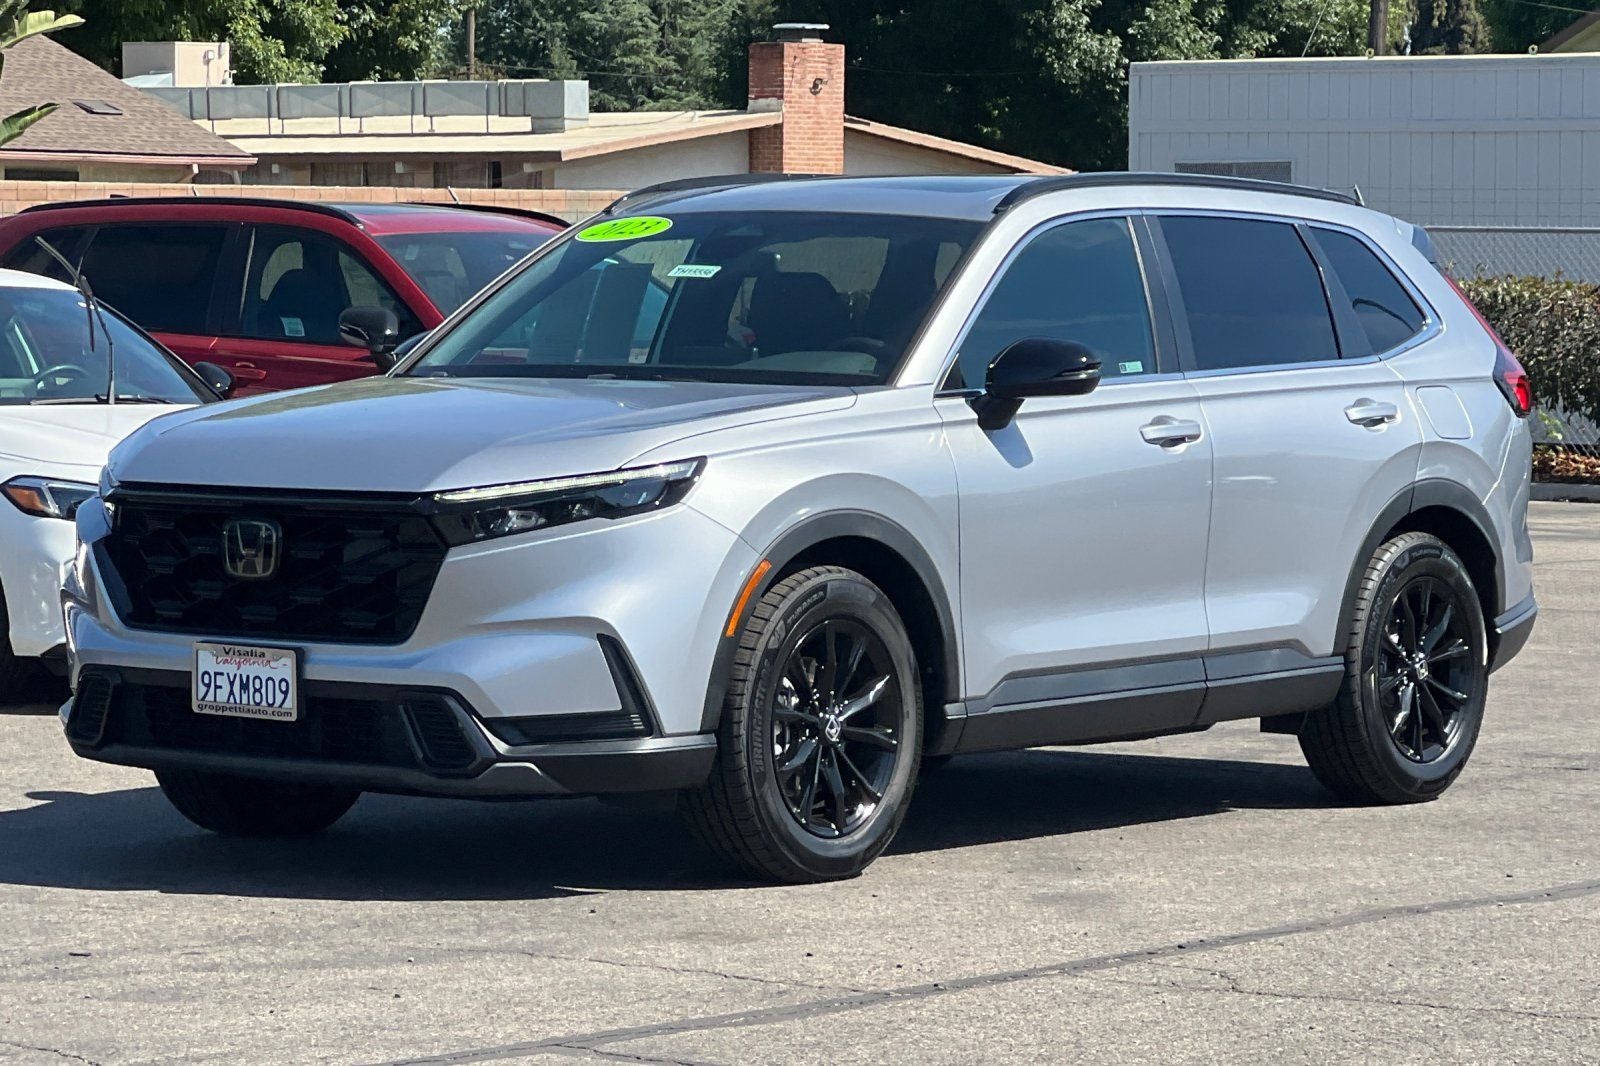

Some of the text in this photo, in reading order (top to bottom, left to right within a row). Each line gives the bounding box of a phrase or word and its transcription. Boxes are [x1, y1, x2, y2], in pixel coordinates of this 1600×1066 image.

[223, 646, 266, 658] Visalia
[201, 670, 290, 709] 9FXM809
[197, 702, 292, 717] groppettiauto.com
